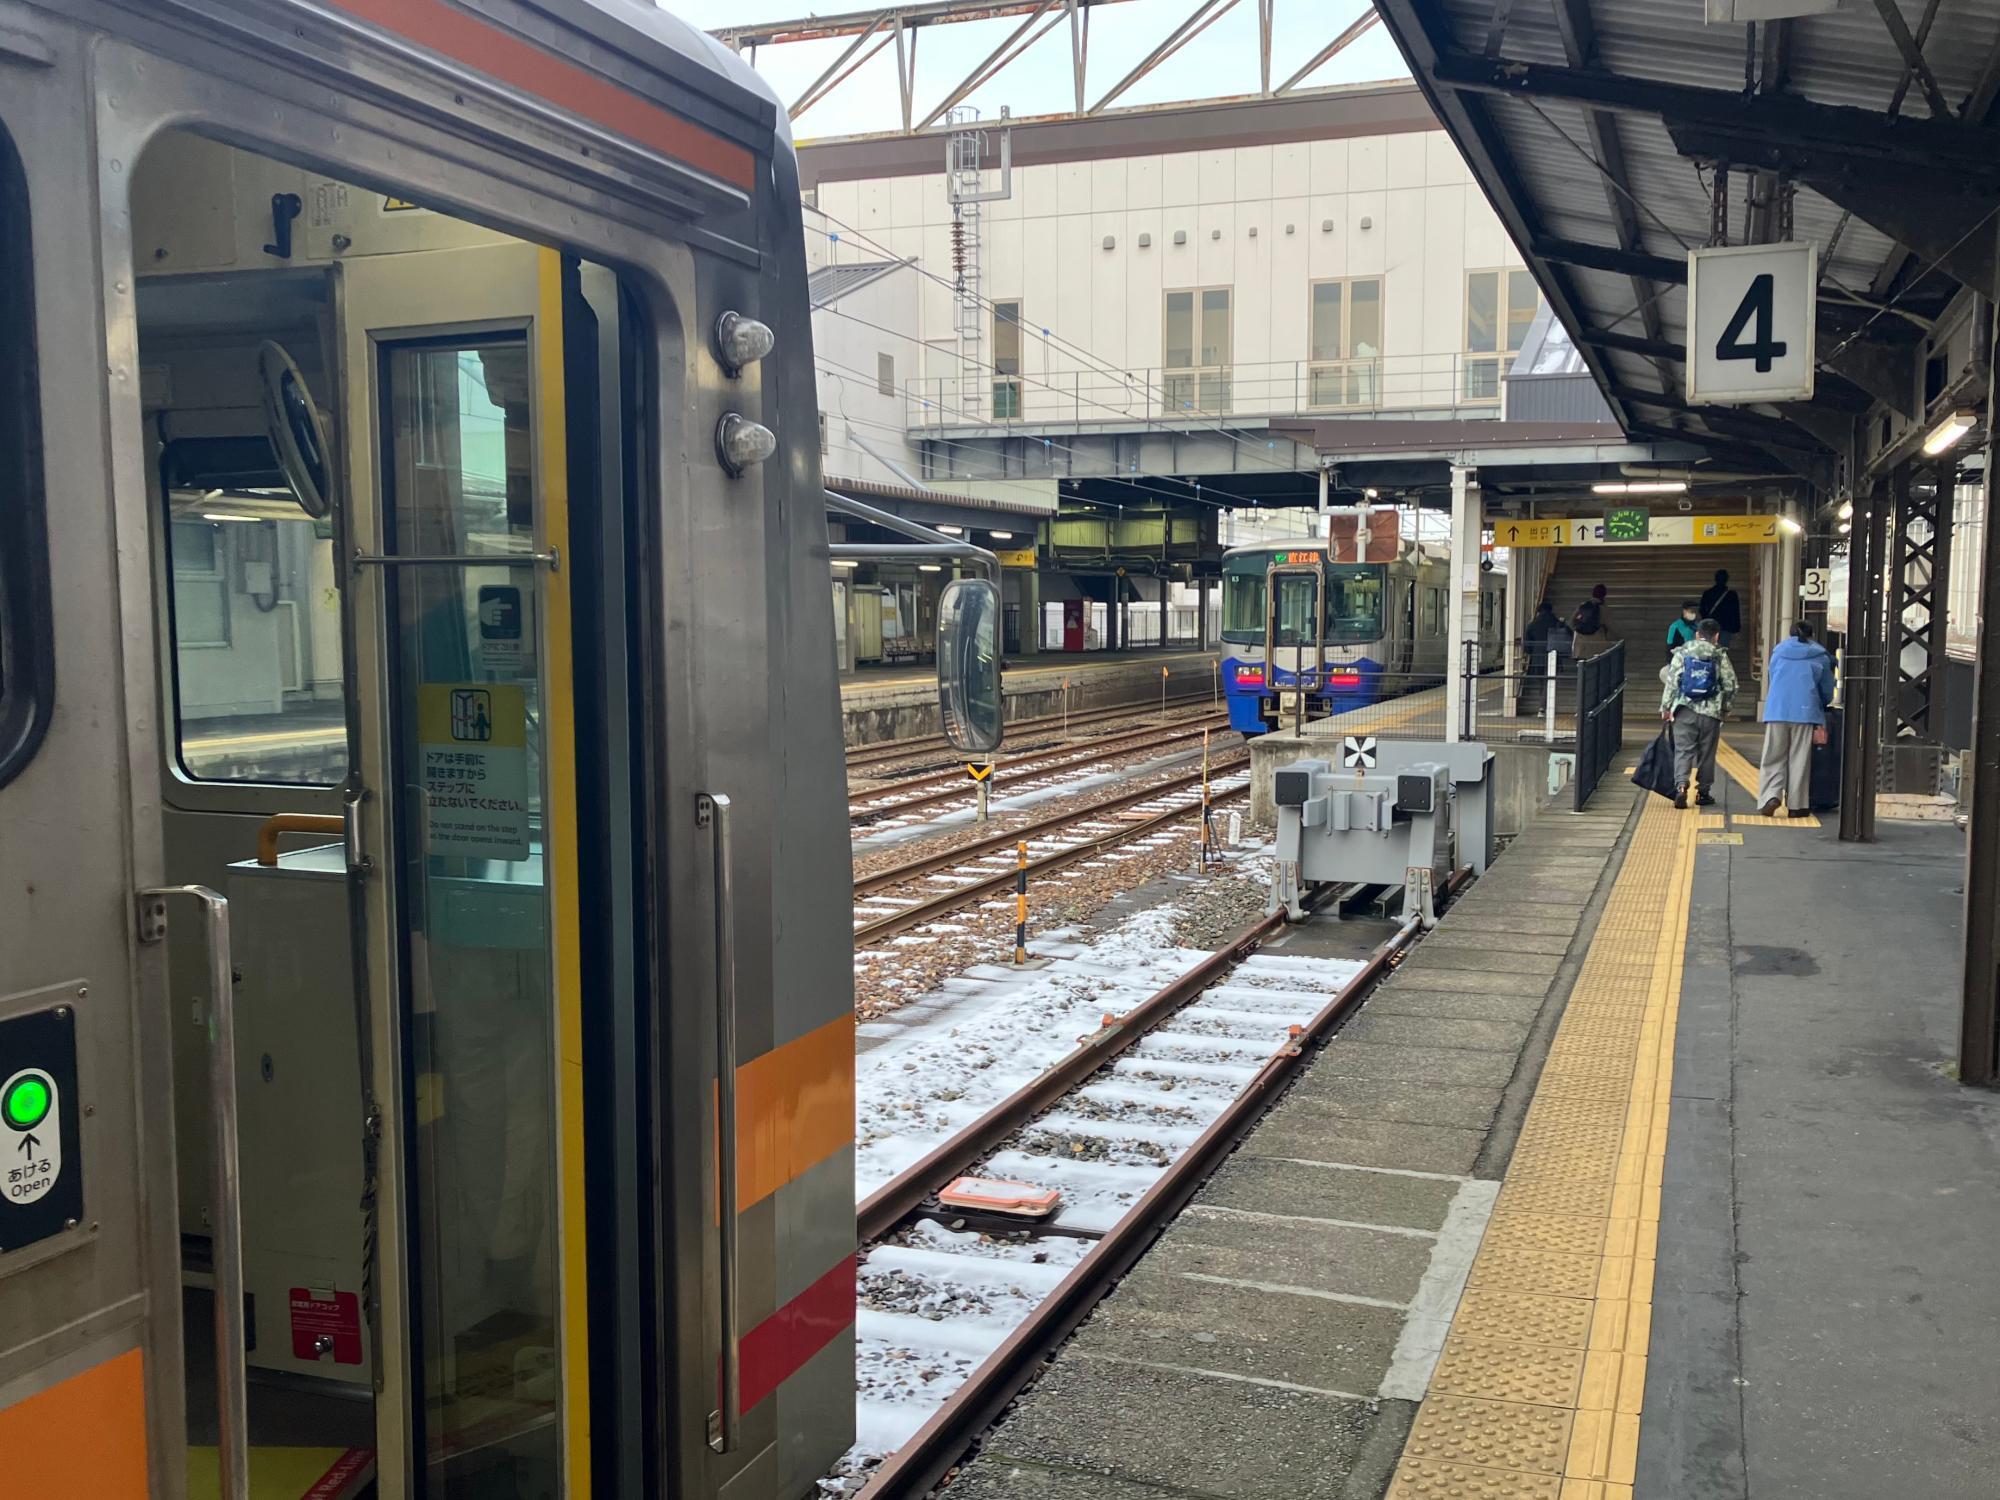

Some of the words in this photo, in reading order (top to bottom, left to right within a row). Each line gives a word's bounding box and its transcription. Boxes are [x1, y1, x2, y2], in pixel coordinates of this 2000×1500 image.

[1716, 274, 1787, 373] 4
[1530, 527, 1549, 535] 出口
[1553, 525, 1563, 544] 1
[1807, 571, 1821, 595] 3
[426, 752, 486, 766] ドアは手前に
[426, 766, 487, 780] 開きますから
[427, 781, 476, 794] ステップに
[429, 796, 524, 812] 立たないでください。
[8, 1159, 51, 1183] あける
[11, 1177, 51, 1197] Open
